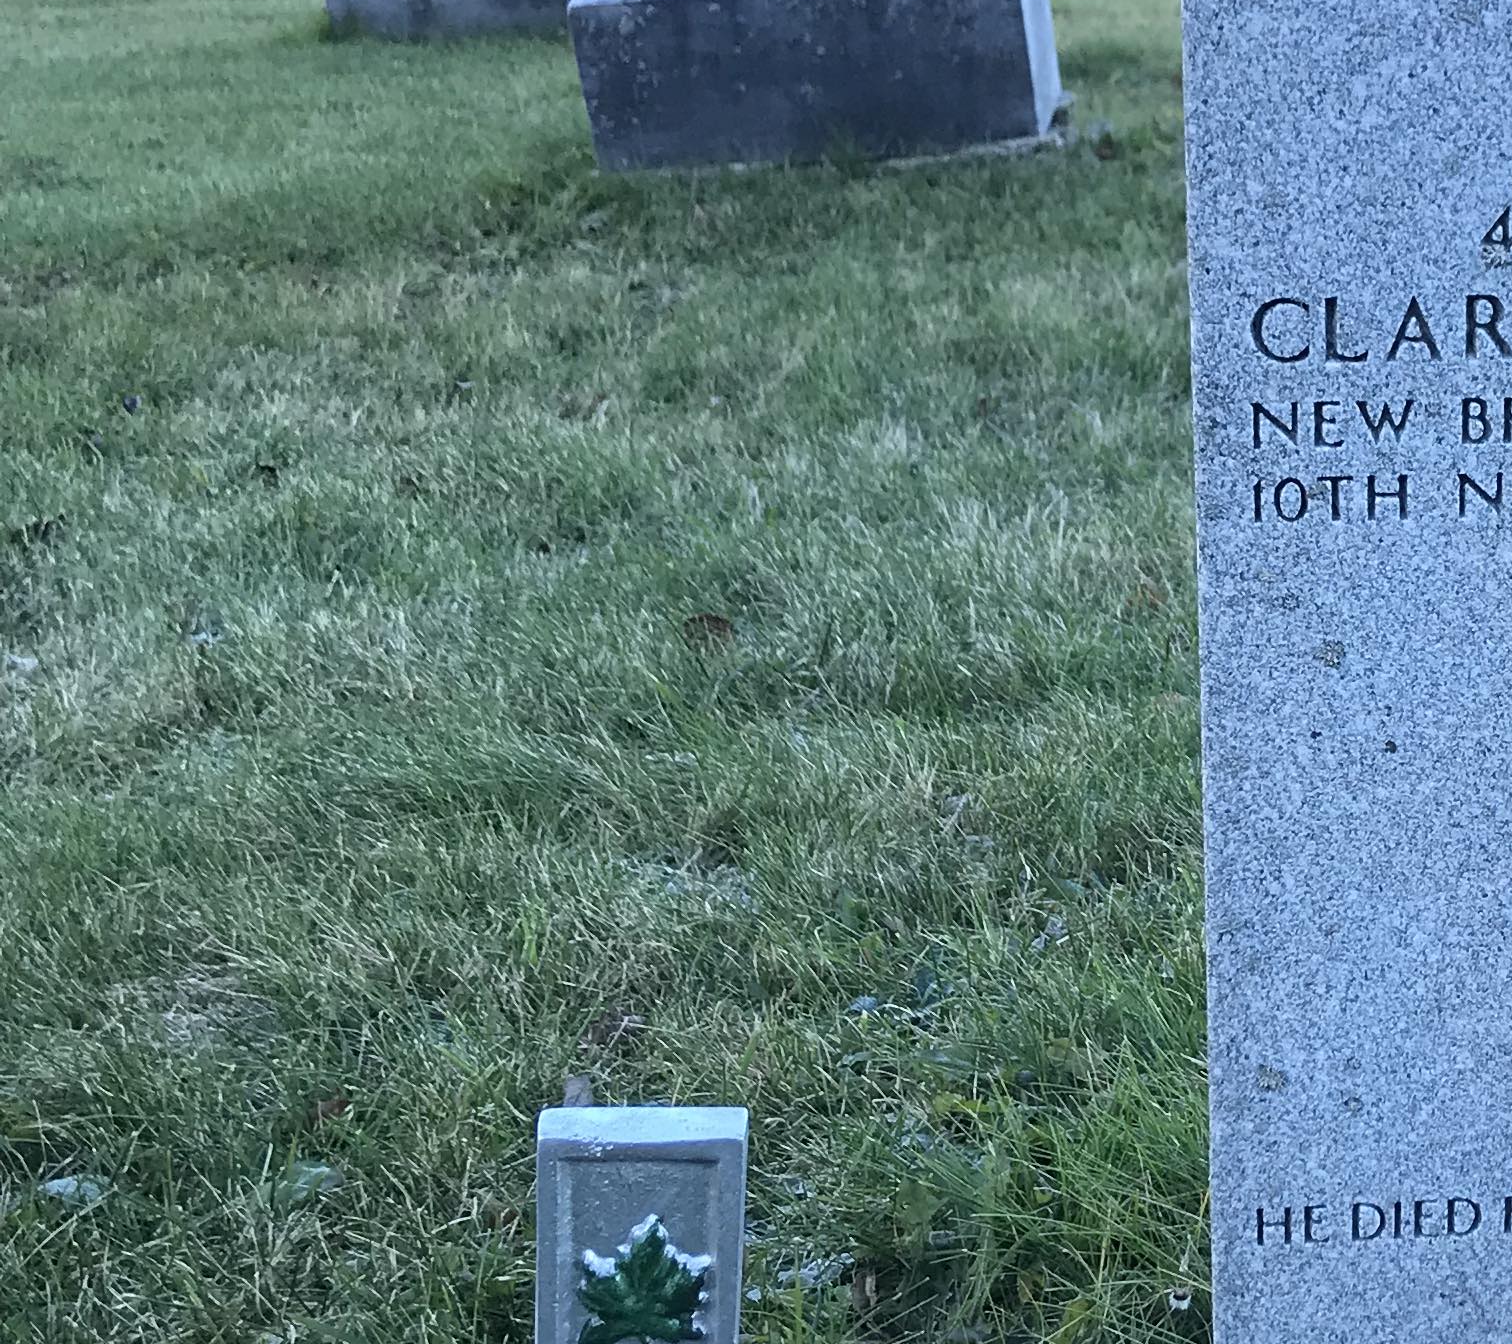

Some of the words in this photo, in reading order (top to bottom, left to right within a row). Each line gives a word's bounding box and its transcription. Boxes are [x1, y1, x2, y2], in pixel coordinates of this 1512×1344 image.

[1251, 399, 1414, 448] NEW
[1253, 473, 1408, 522] 10TH
[1256, 1204, 1330, 1246] HE
[1351, 1197, 1482, 1241] DIED
